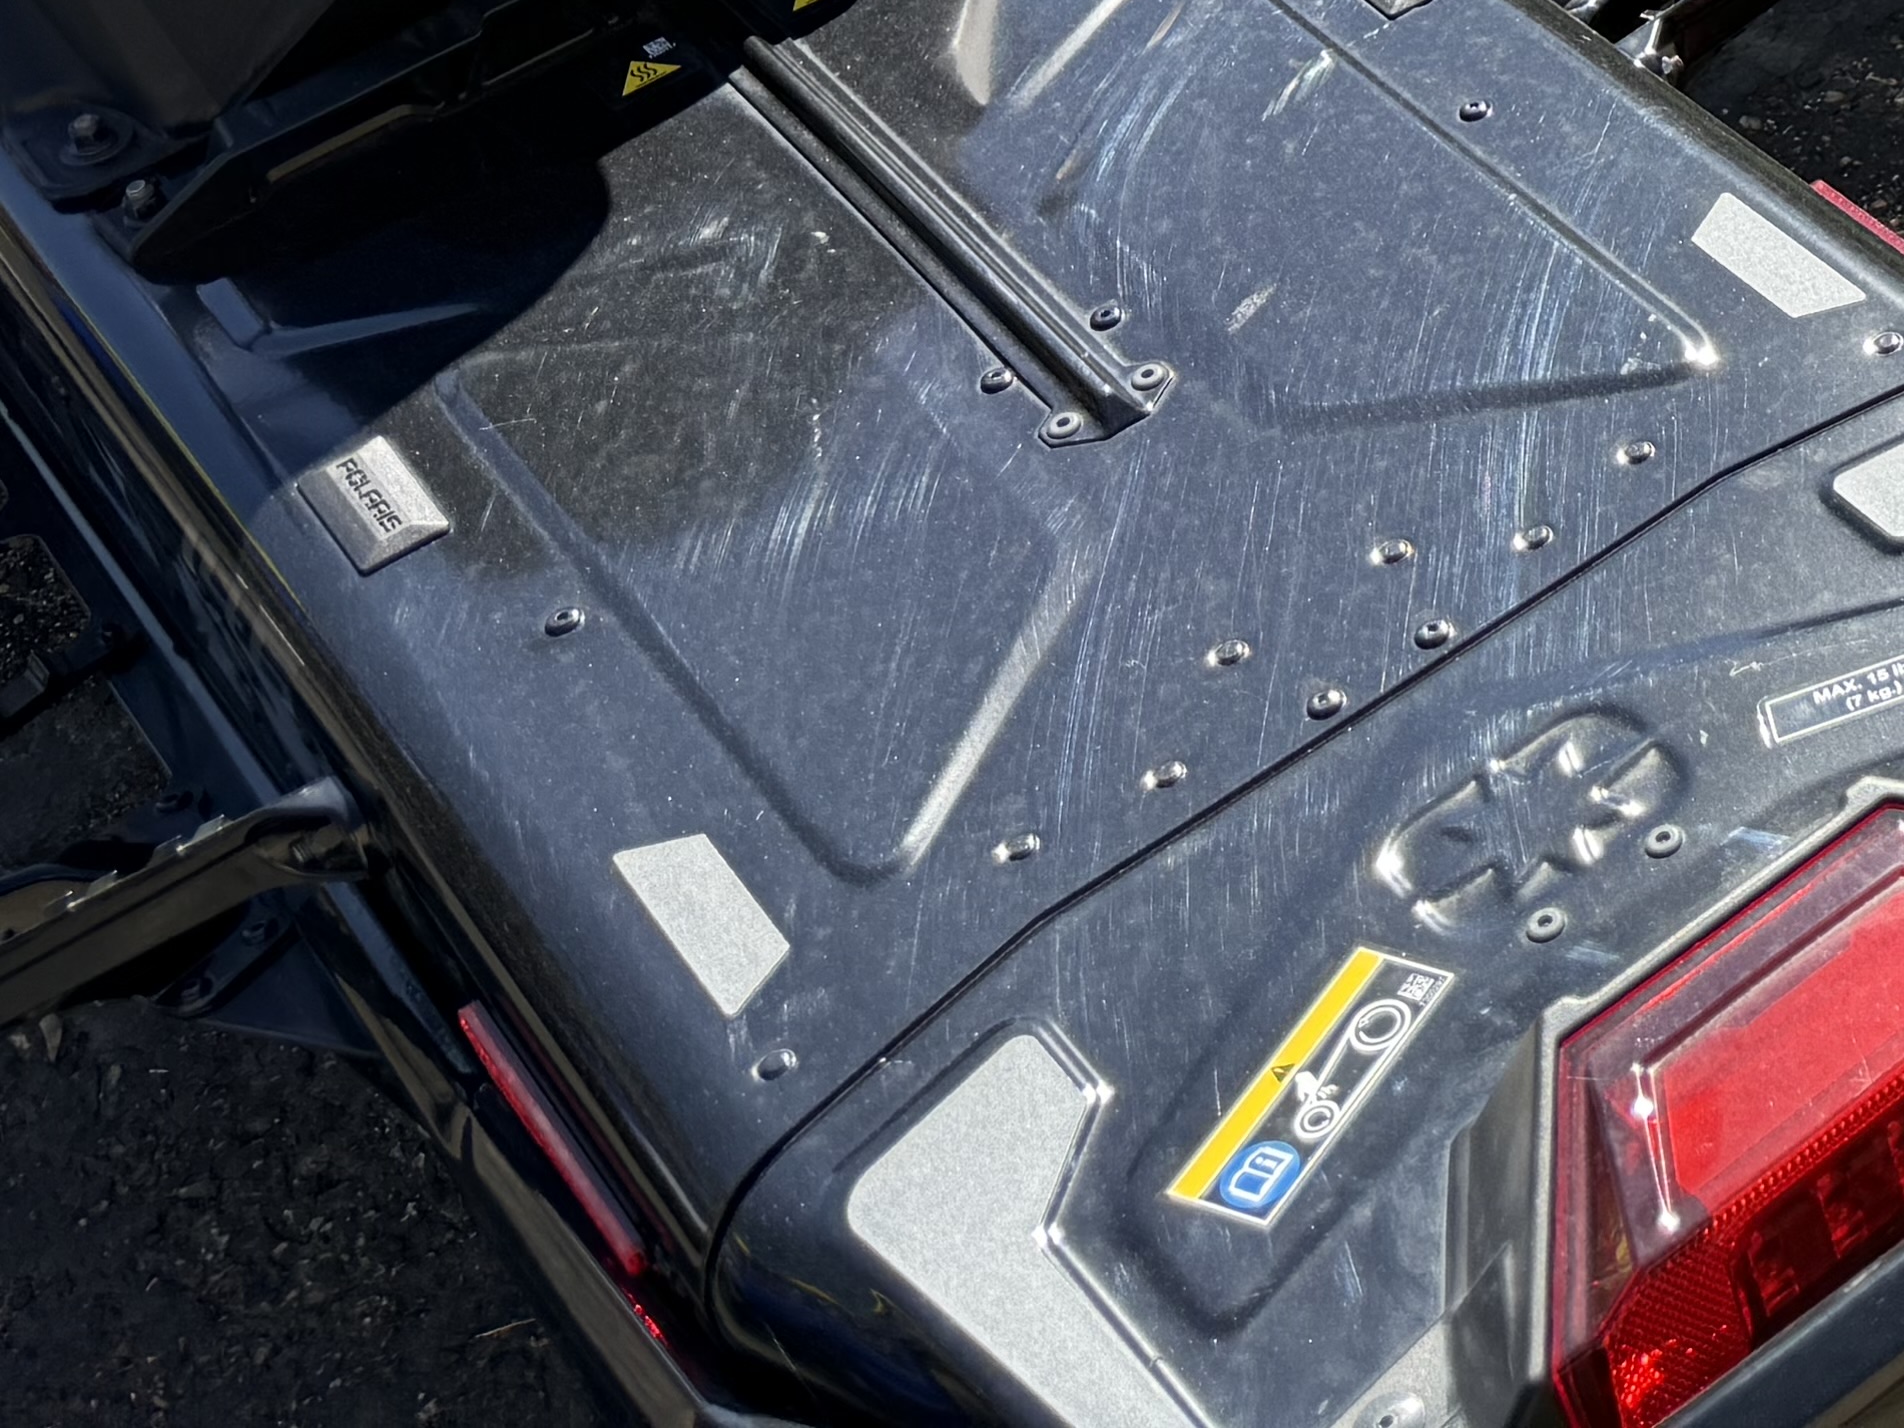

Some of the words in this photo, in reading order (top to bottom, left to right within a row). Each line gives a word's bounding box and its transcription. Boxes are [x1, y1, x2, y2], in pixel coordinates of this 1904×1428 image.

[336, 457, 403, 534] POLARIS
[1812, 679, 1863, 705] MAX.
[1866, 668, 1890, 686] 15
[1845, 694, 1862, 711] (7
[1867, 680, 1903, 704] kg.)
